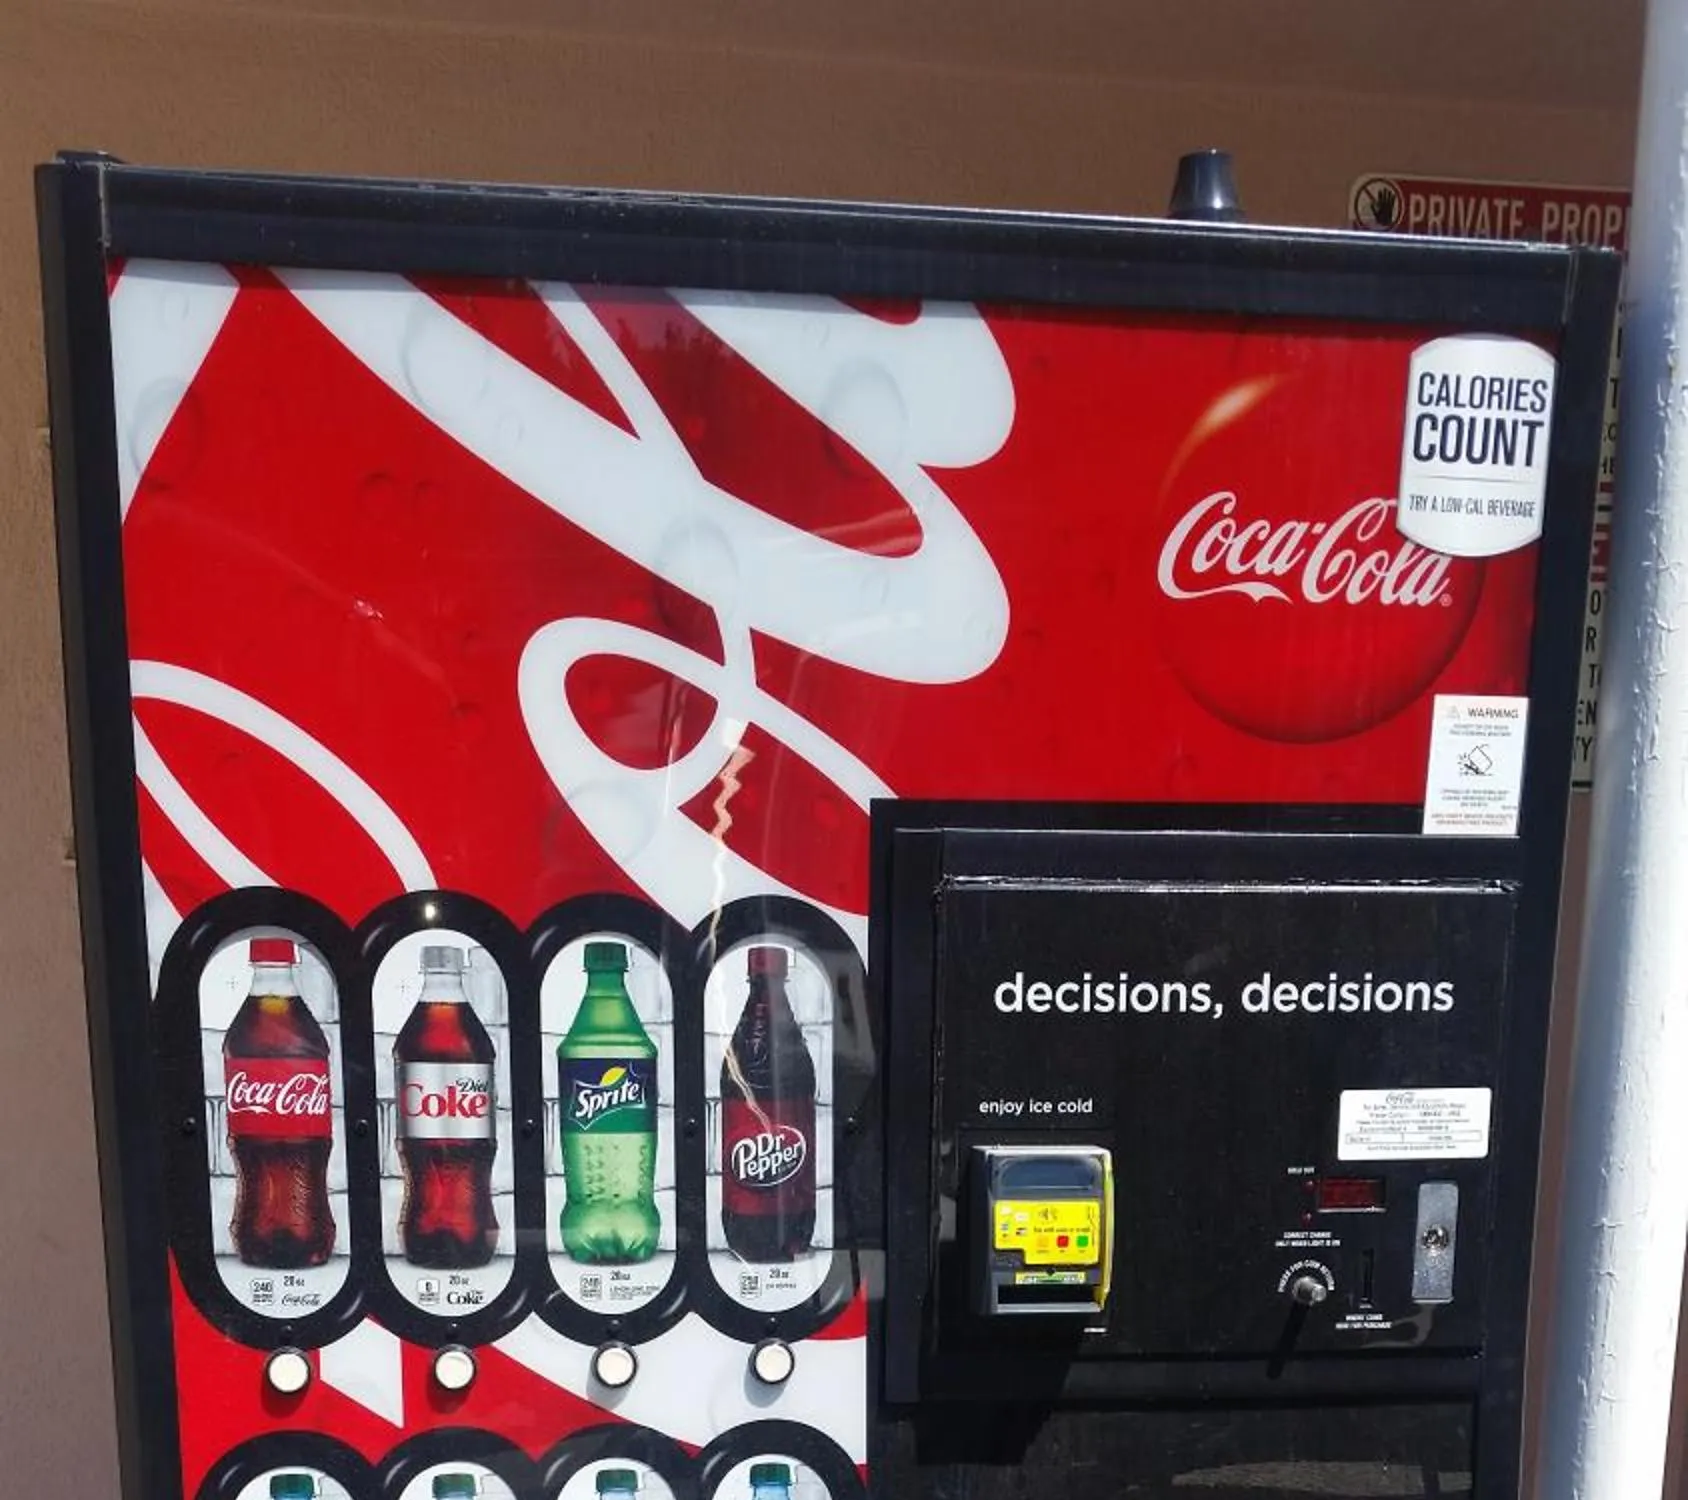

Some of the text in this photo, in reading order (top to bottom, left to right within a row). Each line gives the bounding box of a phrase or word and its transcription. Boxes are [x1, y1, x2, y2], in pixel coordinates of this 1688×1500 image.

[1408, 193, 1631, 248] PRIVATE PROP
[1417, 371, 1548, 413] CALORIES
[1413, 412, 1545, 467] COUNT
[1409, 494, 1428, 511] TRY
[1430, 496, 1437, 512] A
[1487, 499, 1536, 517] BEVERAGE
[1157, 491, 1453, 606] Coca-Cola
[1467, 707, 1519, 719] WARNING
[994, 972, 1455, 1019] decisions, decisions
[228, 1071, 329, 1115] Coca-Cola
[401, 1083, 489, 1118] Coke
[456, 1077, 489, 1092] Diet
[575, 1079, 640, 1119] Sprite
[979, 1098, 1093, 1116] enjoy ice cold
[732, 1138, 801, 1180] Pepper
[756, 1132, 785, 1156] Dr
